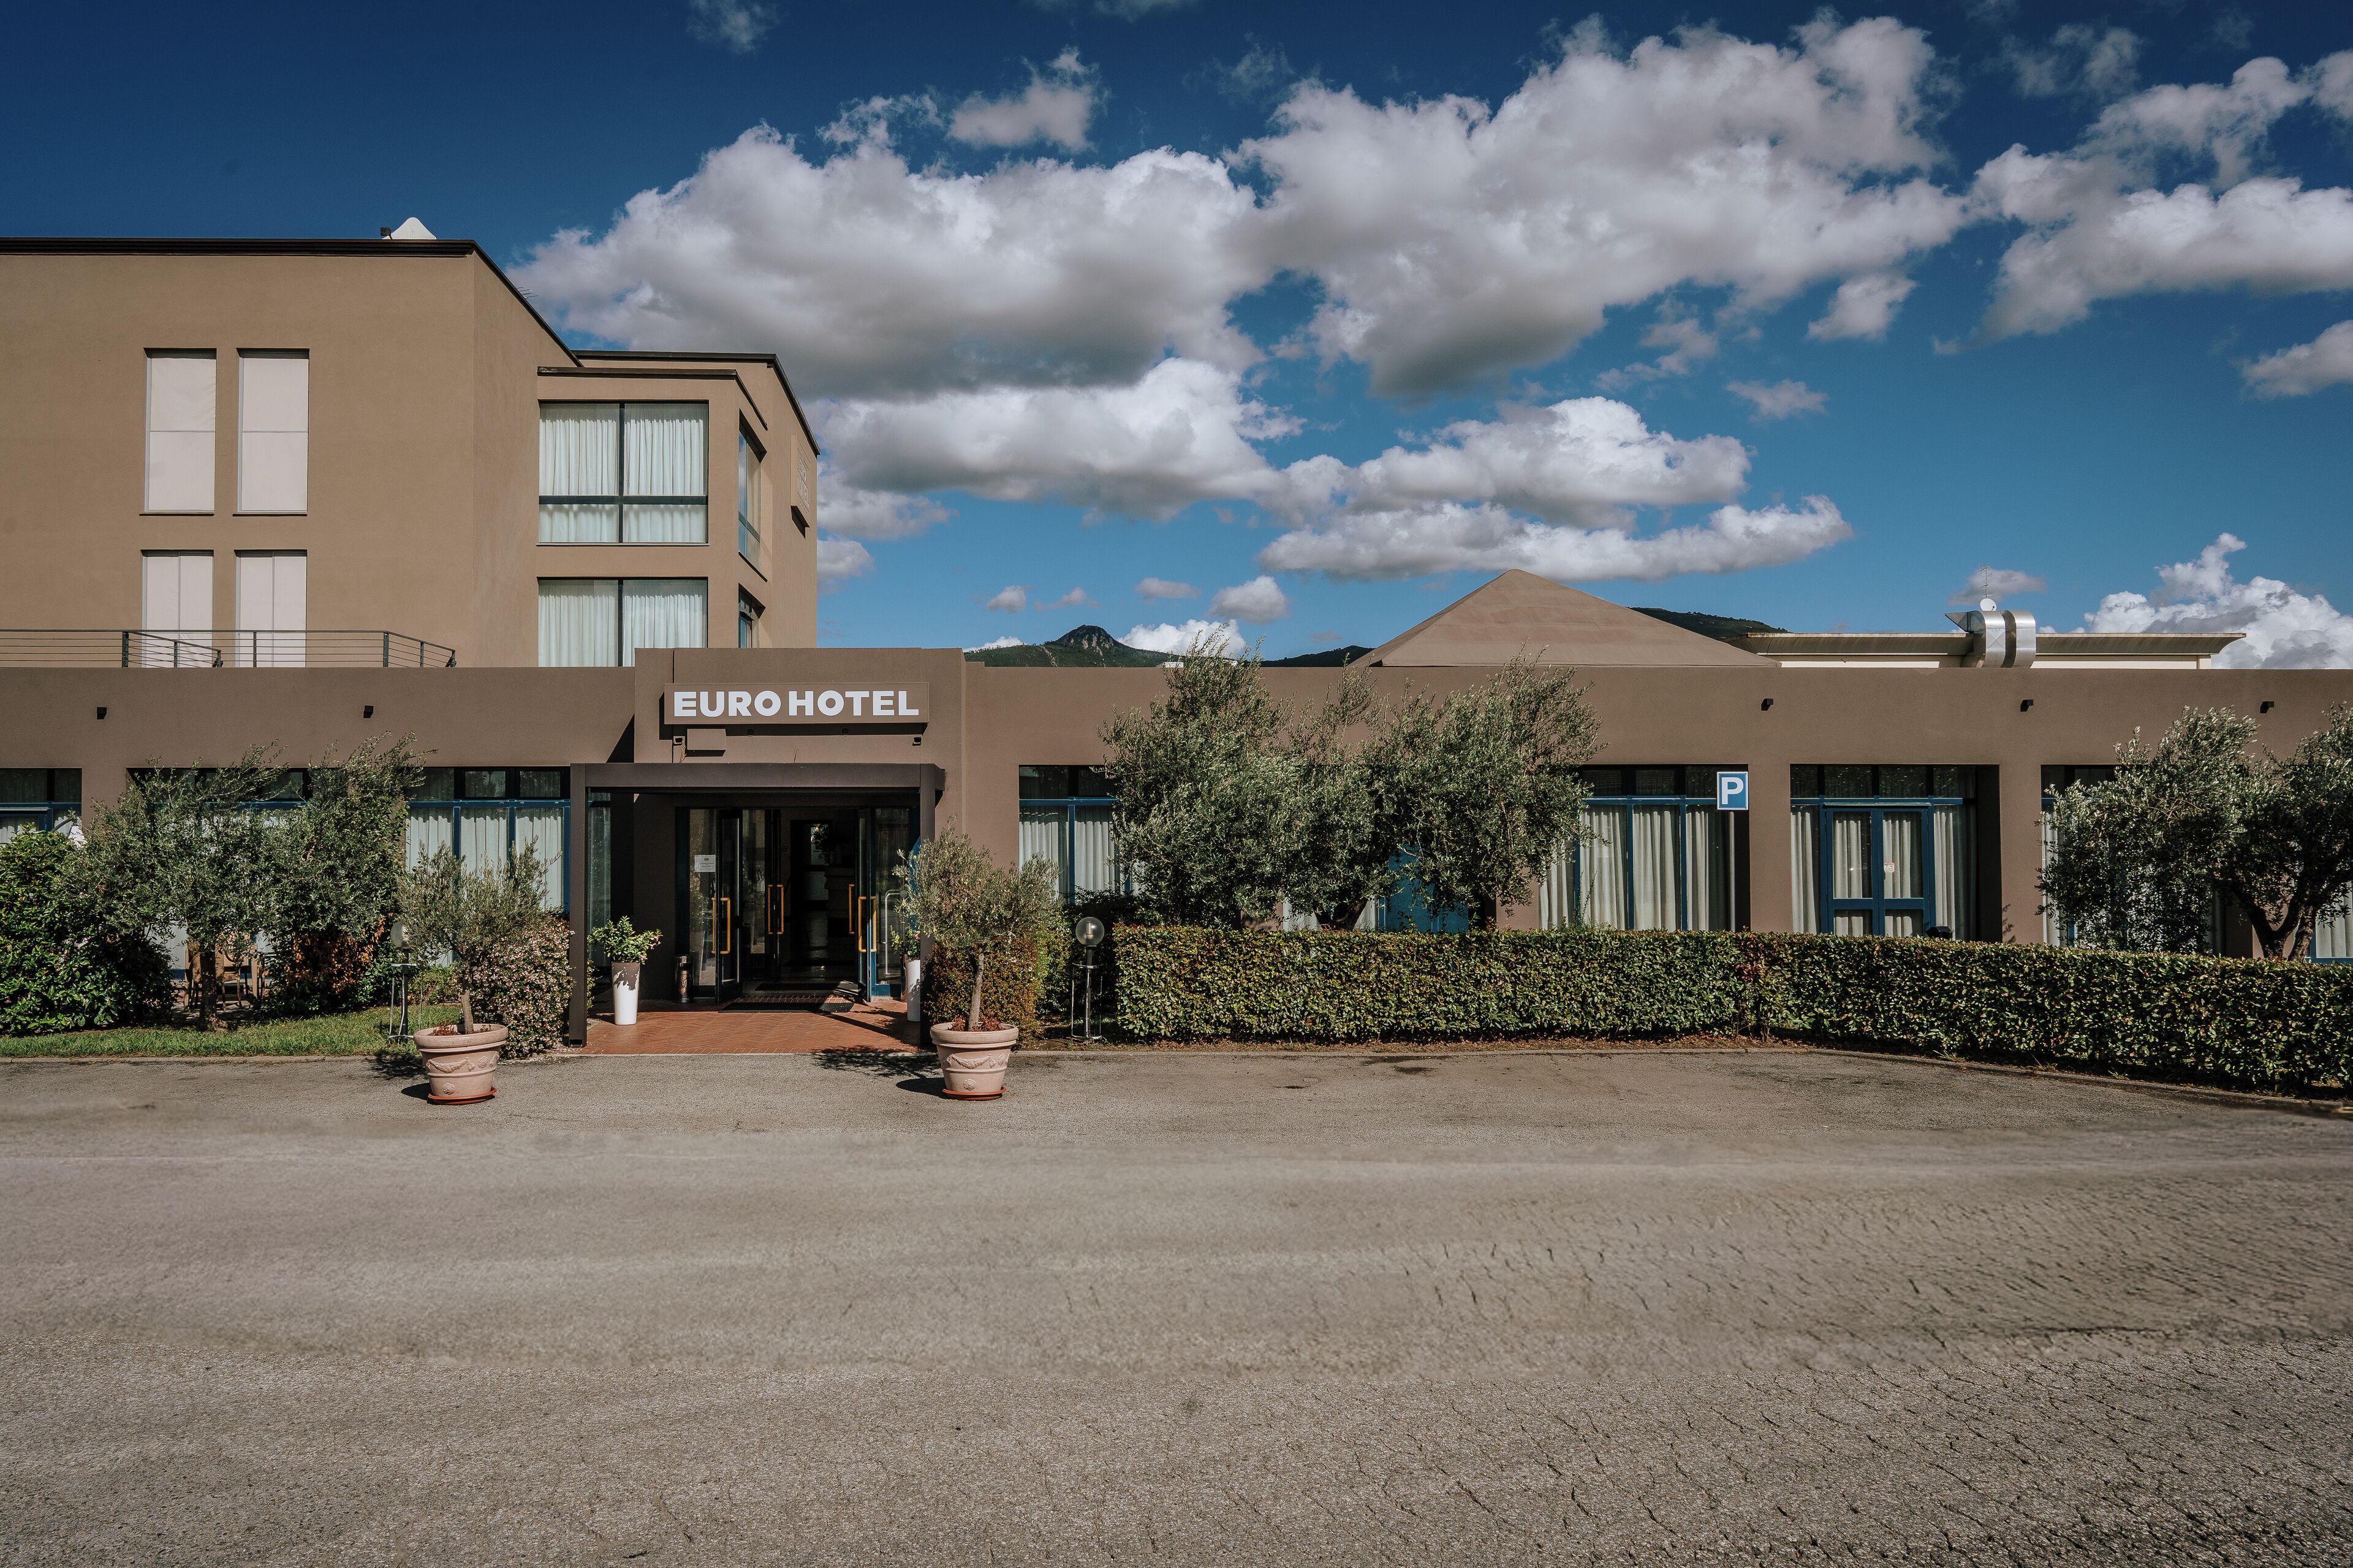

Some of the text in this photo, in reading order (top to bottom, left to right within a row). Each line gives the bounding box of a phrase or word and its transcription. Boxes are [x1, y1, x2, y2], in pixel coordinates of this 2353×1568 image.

[674, 690, 919, 717] EURO HOTEL
[1721, 777, 1744, 805] P
